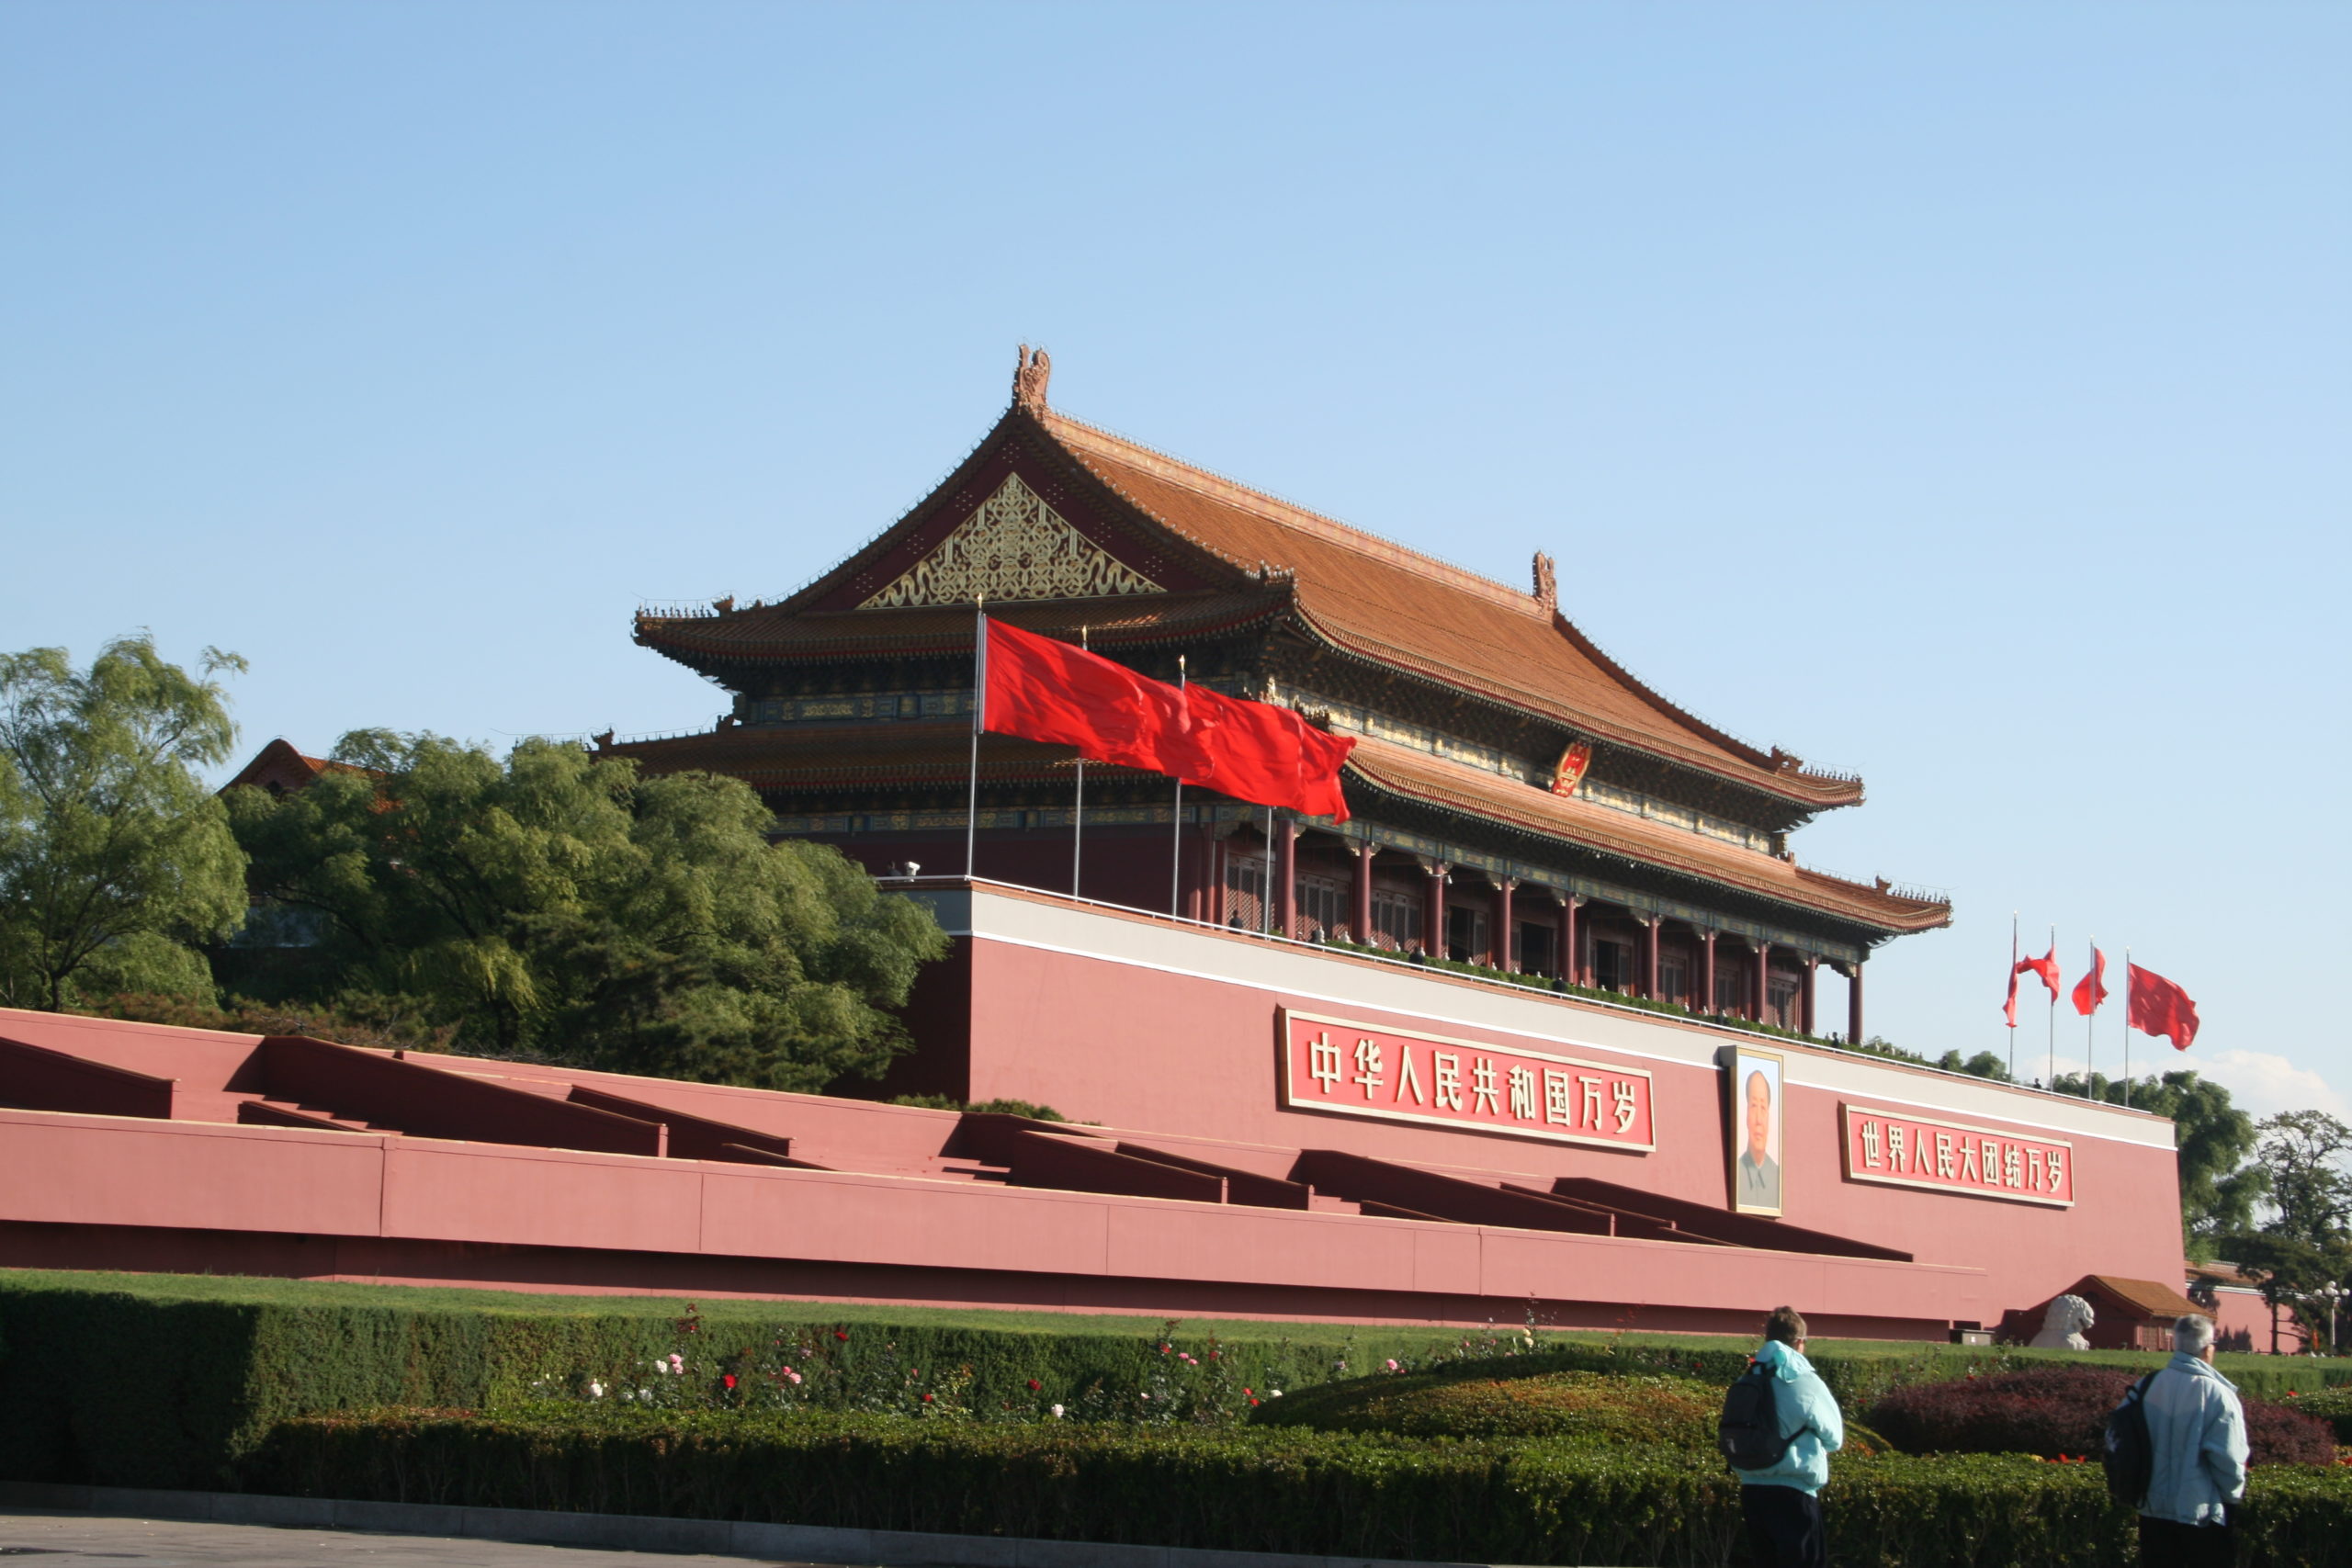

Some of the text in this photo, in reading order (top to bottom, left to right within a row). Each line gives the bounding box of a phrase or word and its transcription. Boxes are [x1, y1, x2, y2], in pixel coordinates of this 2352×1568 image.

[1309, 1032, 1636, 1134] 中华人民共和国万岁
[1861, 1121, 2063, 1193] 世界人民大团结万岁
